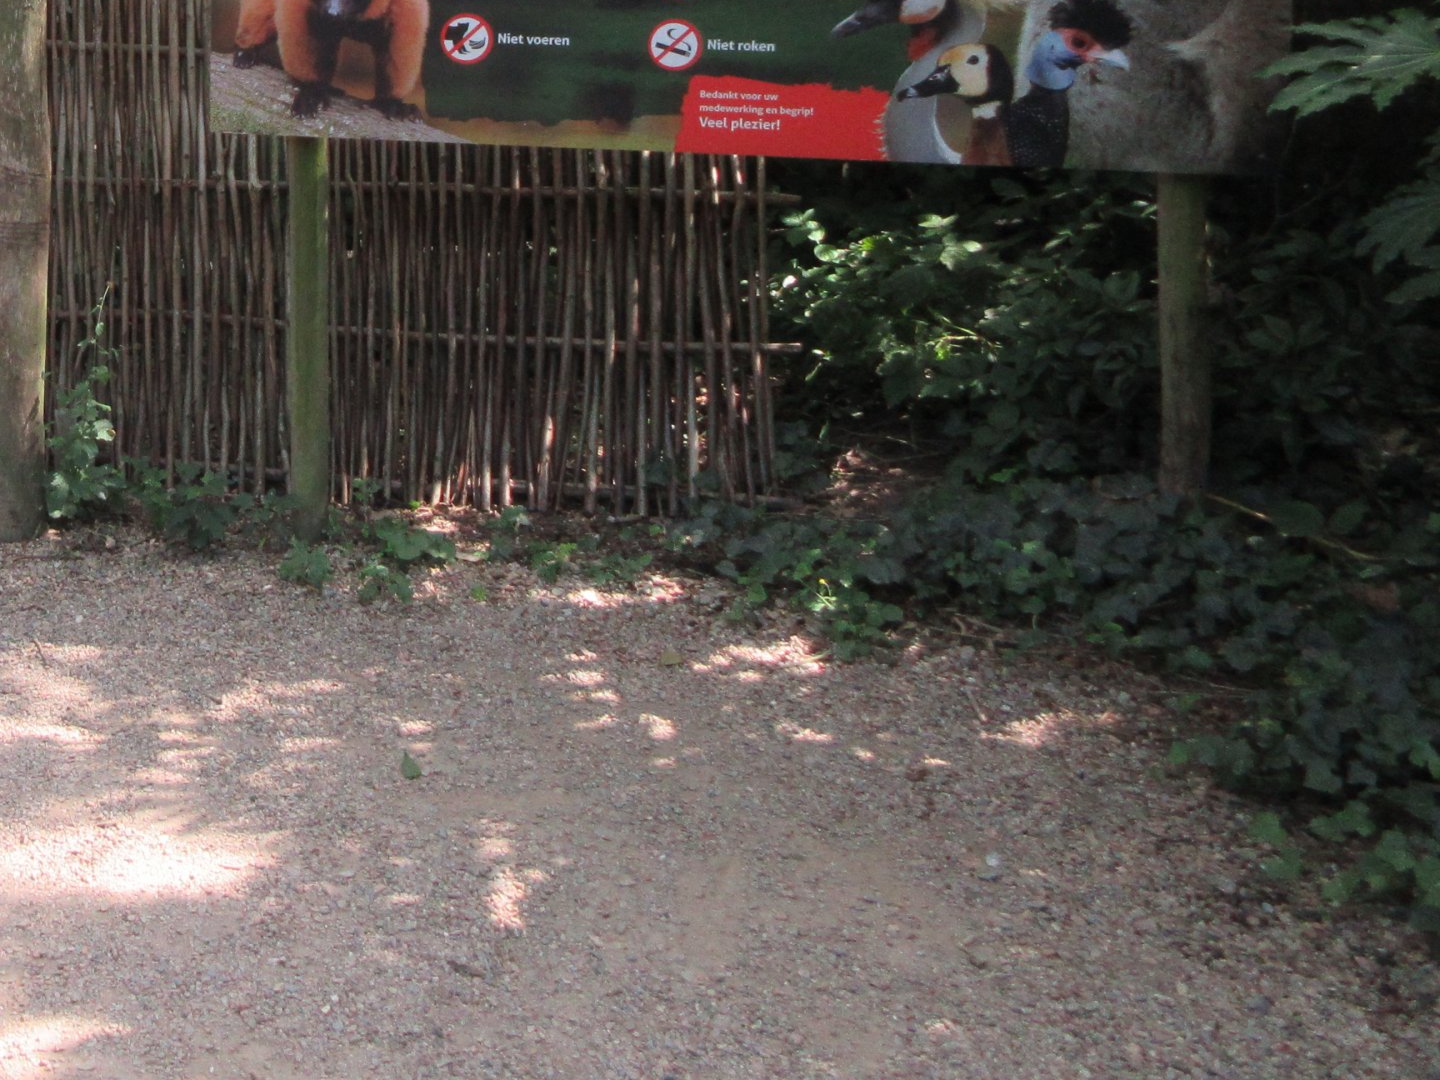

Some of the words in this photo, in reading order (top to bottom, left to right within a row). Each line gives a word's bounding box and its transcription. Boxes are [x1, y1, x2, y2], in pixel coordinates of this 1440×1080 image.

[498, 33, 524, 44] Niet
[527, 36, 570, 45] voeren
[707, 39, 734, 50] Niet
[738, 40, 775, 52] roken
[700, 90, 738, 98] Bedankt
[700, 104, 764, 115] medewerking
[780, 106, 814, 117] begrip!
[700, 117, 727, 128] Veel
[731, 118, 780, 131] plezier!
